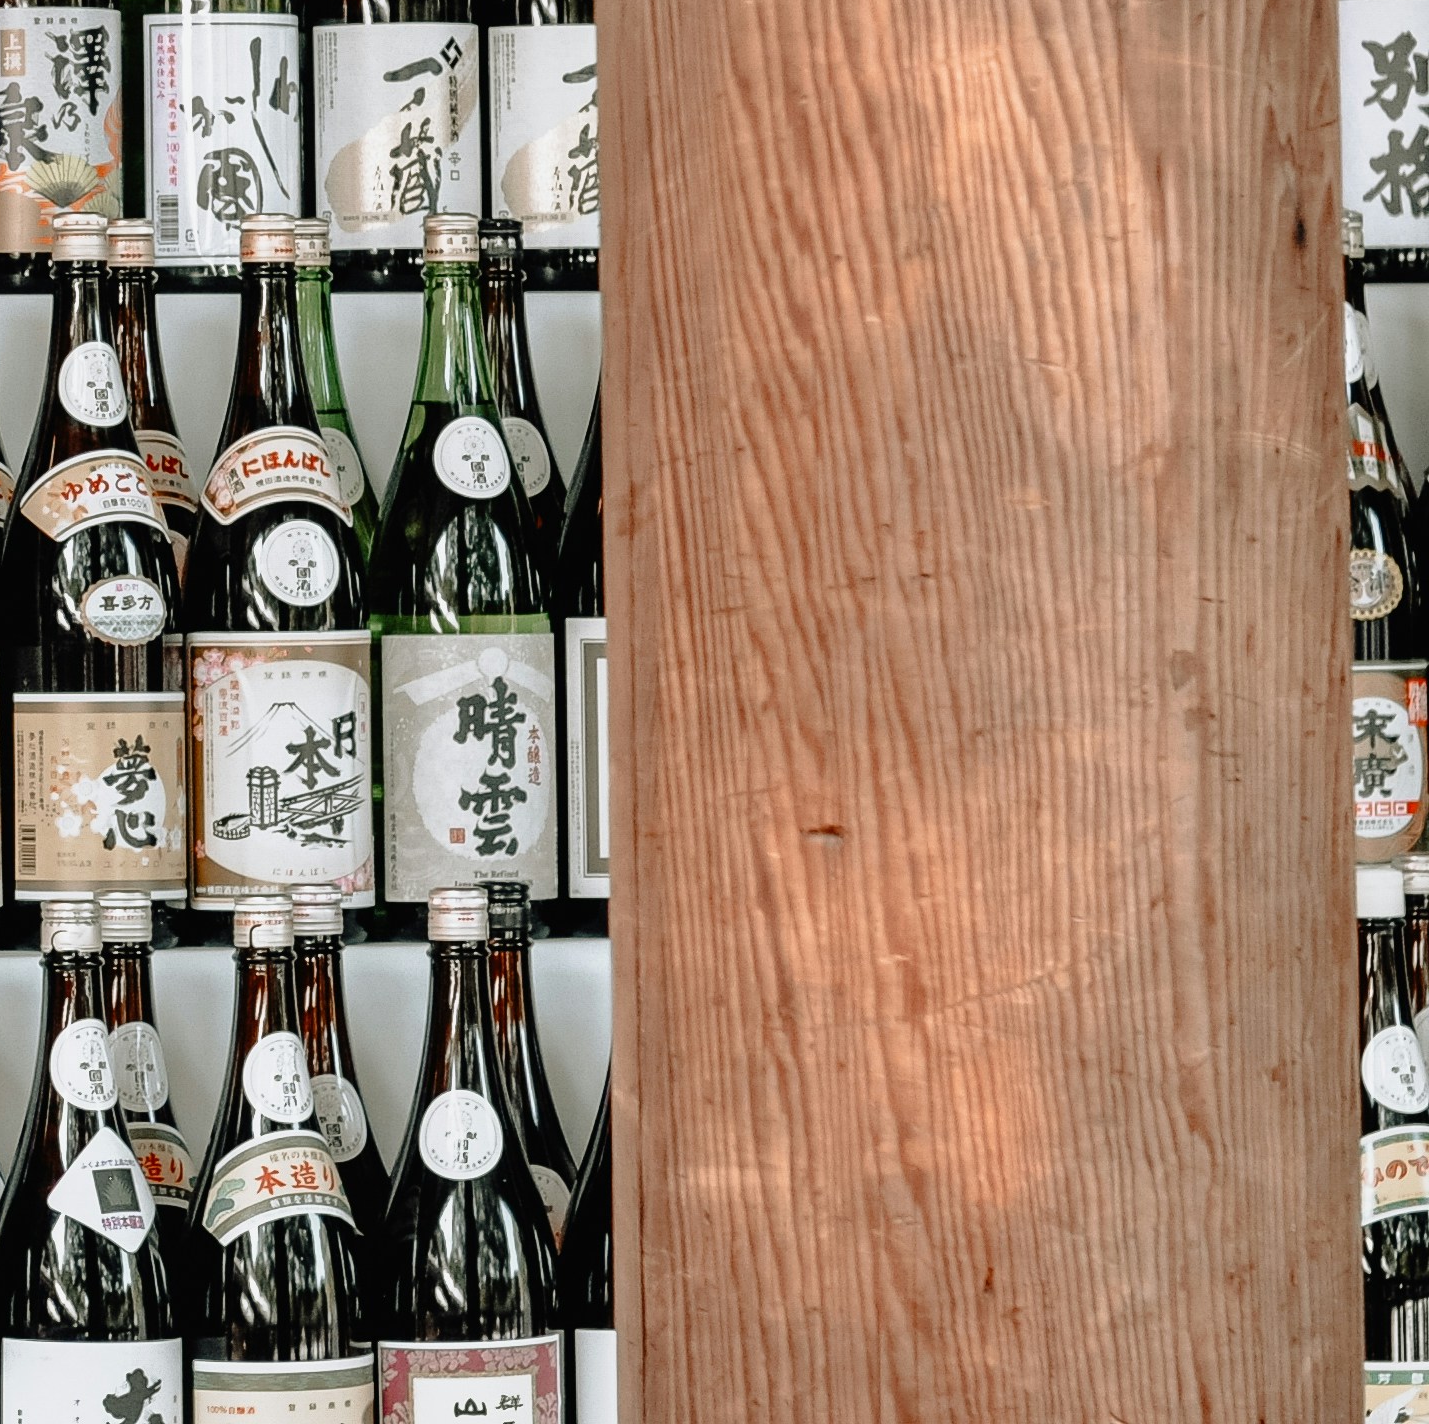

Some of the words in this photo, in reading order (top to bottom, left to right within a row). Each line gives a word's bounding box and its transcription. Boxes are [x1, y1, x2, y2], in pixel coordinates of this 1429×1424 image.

[2, 33, 23, 73] 上撰
[448, 152, 461, 180] 辛口
[240, 448, 333, 480] にほんばし
[98, 594, 153, 613] 喜多方
[452, 677, 529, 858] 晴雲
[526, 724, 543, 788] 本醸造
[103, 736, 159, 851] 夢心
[256, 1163, 336, 1196] 本造り
